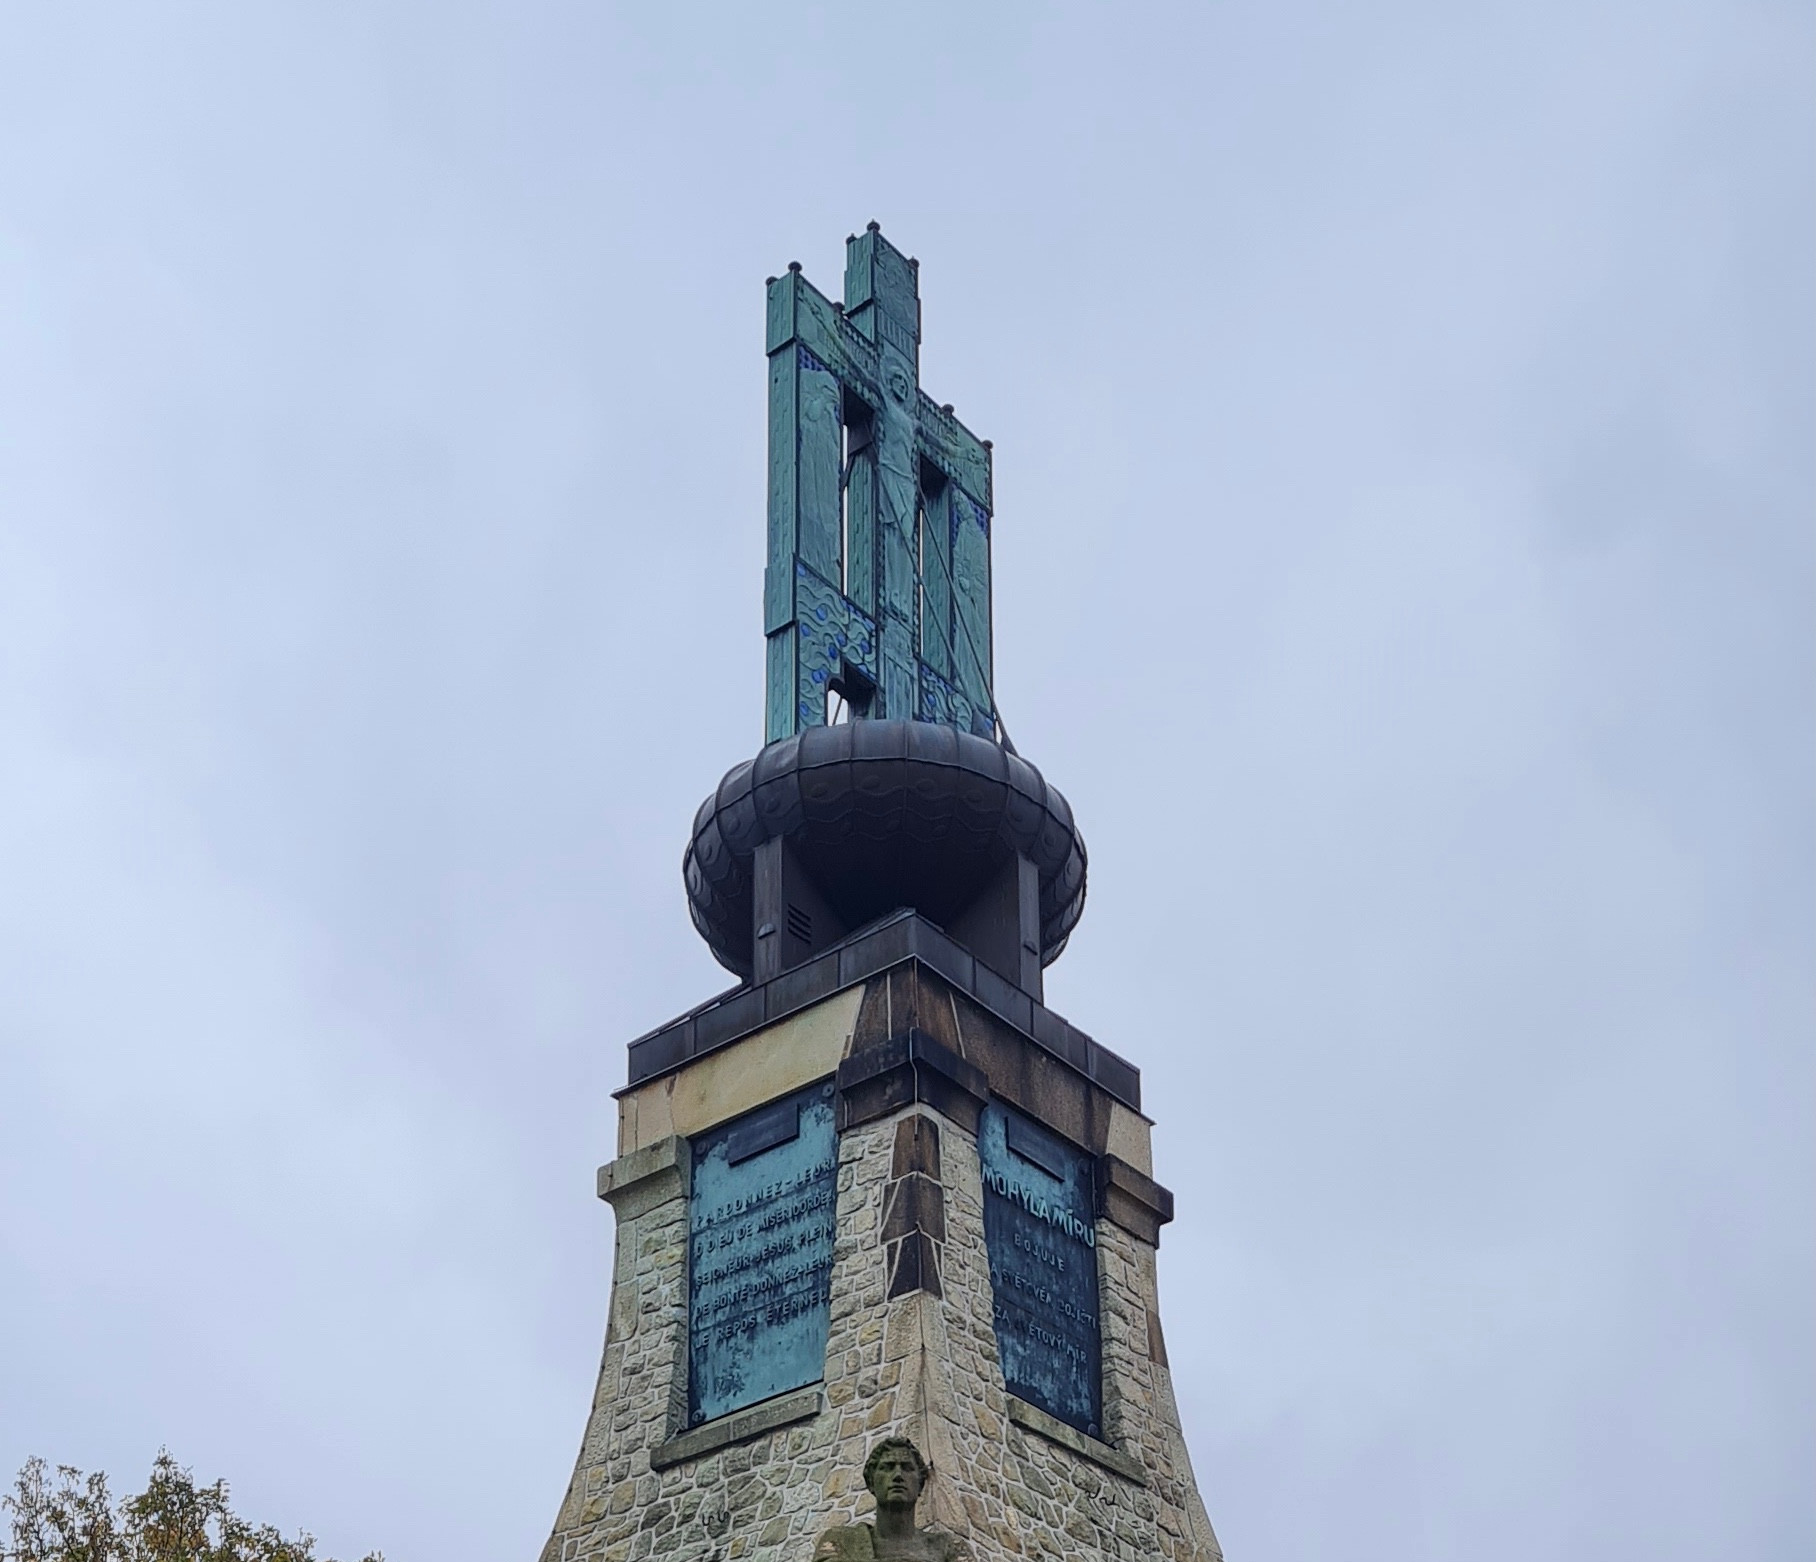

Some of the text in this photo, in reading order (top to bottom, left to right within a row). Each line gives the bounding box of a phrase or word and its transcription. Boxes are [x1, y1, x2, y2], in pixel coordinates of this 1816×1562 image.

[981, 1163, 1095, 1248] MOHYLA MÍRU
[707, 1229, 734, 1253] DIEU
[738, 1223, 754, 1242] DE
[1014, 1233, 1065, 1272] BOJUJE
[695, 1302, 710, 1321] DE
[995, 1305, 1010, 1324] ZA
[695, 1334, 711, 1351] LE
[716, 1315, 757, 1341] REPOS
